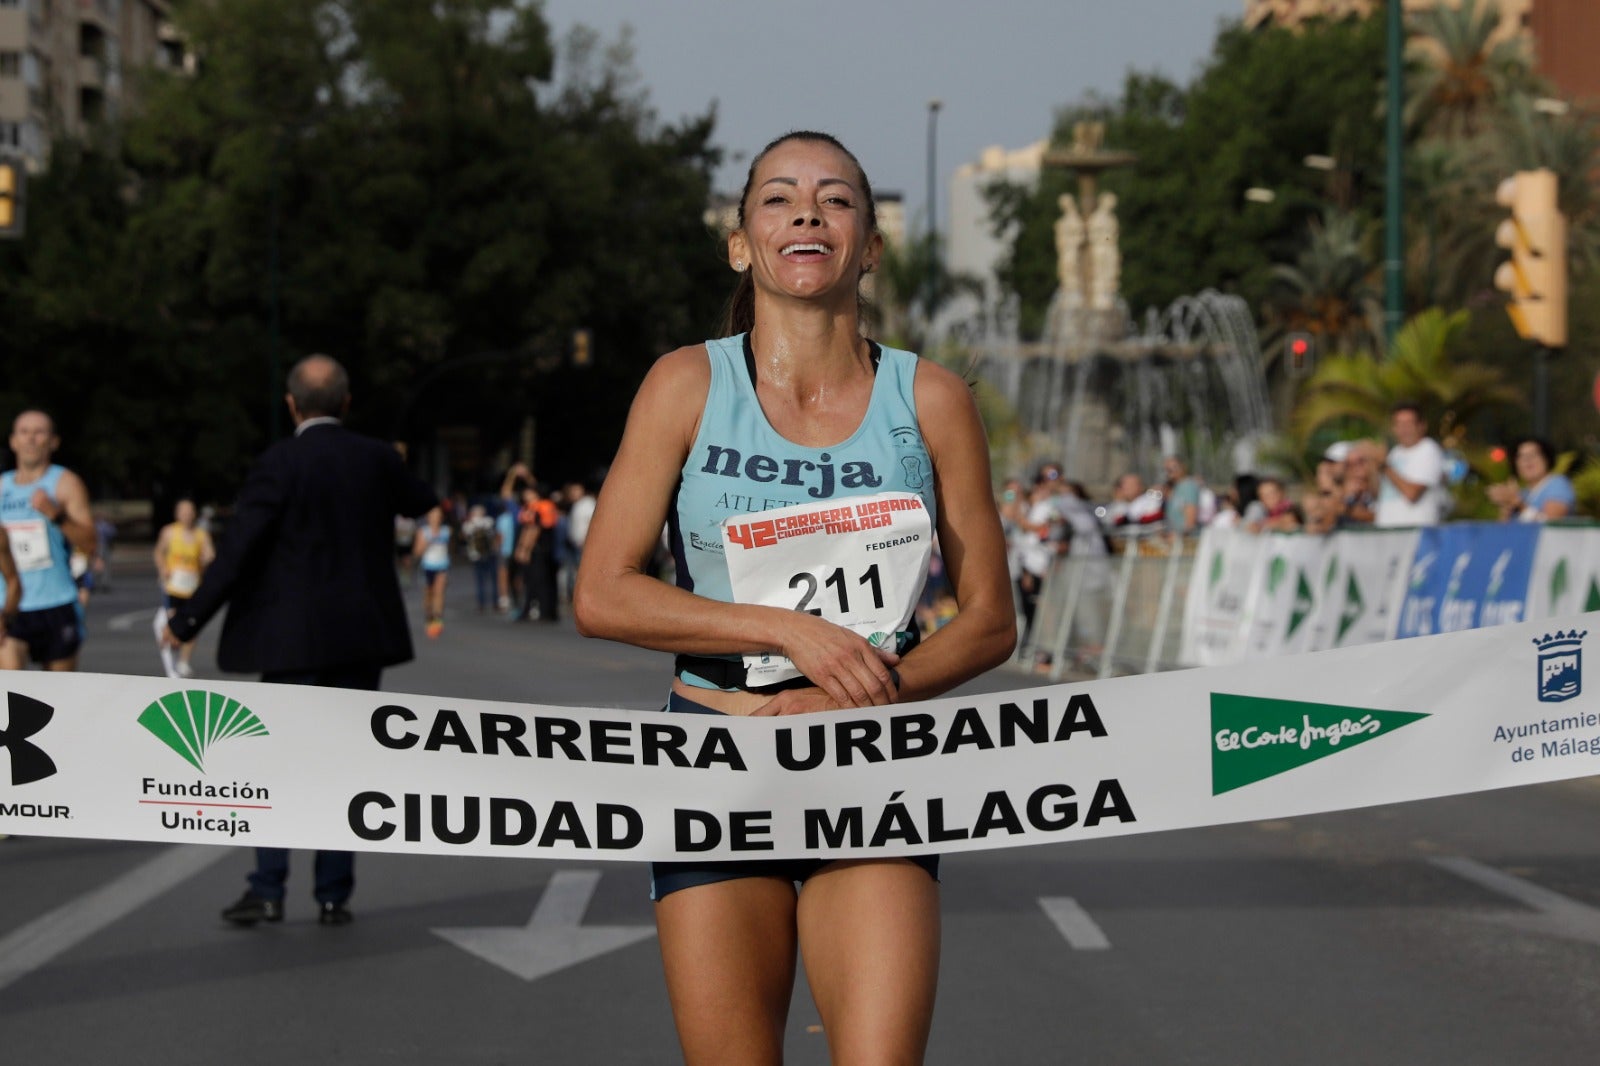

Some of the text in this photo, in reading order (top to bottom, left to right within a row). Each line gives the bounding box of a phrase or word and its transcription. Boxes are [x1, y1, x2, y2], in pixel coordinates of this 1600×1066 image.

[701, 445, 882, 498] nerja
[775, 498, 922, 531] CARRERA URBANA
[777, 526, 816, 540] CIUDAD
[825, 513, 892, 535] MALAGA
[727, 520, 777, 550] 42
[865, 534, 920, 551] FEDERADO
[788, 563, 884, 617] 211
[370, 693, 1108, 771] CARRERA URBANA
[1215, 714, 1381, 751] El Corte Inglés
[1493, 711, 1600, 743] Ayuntamie
[1511, 746, 1535, 763] de
[142, 777, 269, 800] Fundación
[161, 810, 251, 837] Unicaja
[347, 778, 1137, 852] CIUDAD DE MÁLAGA
